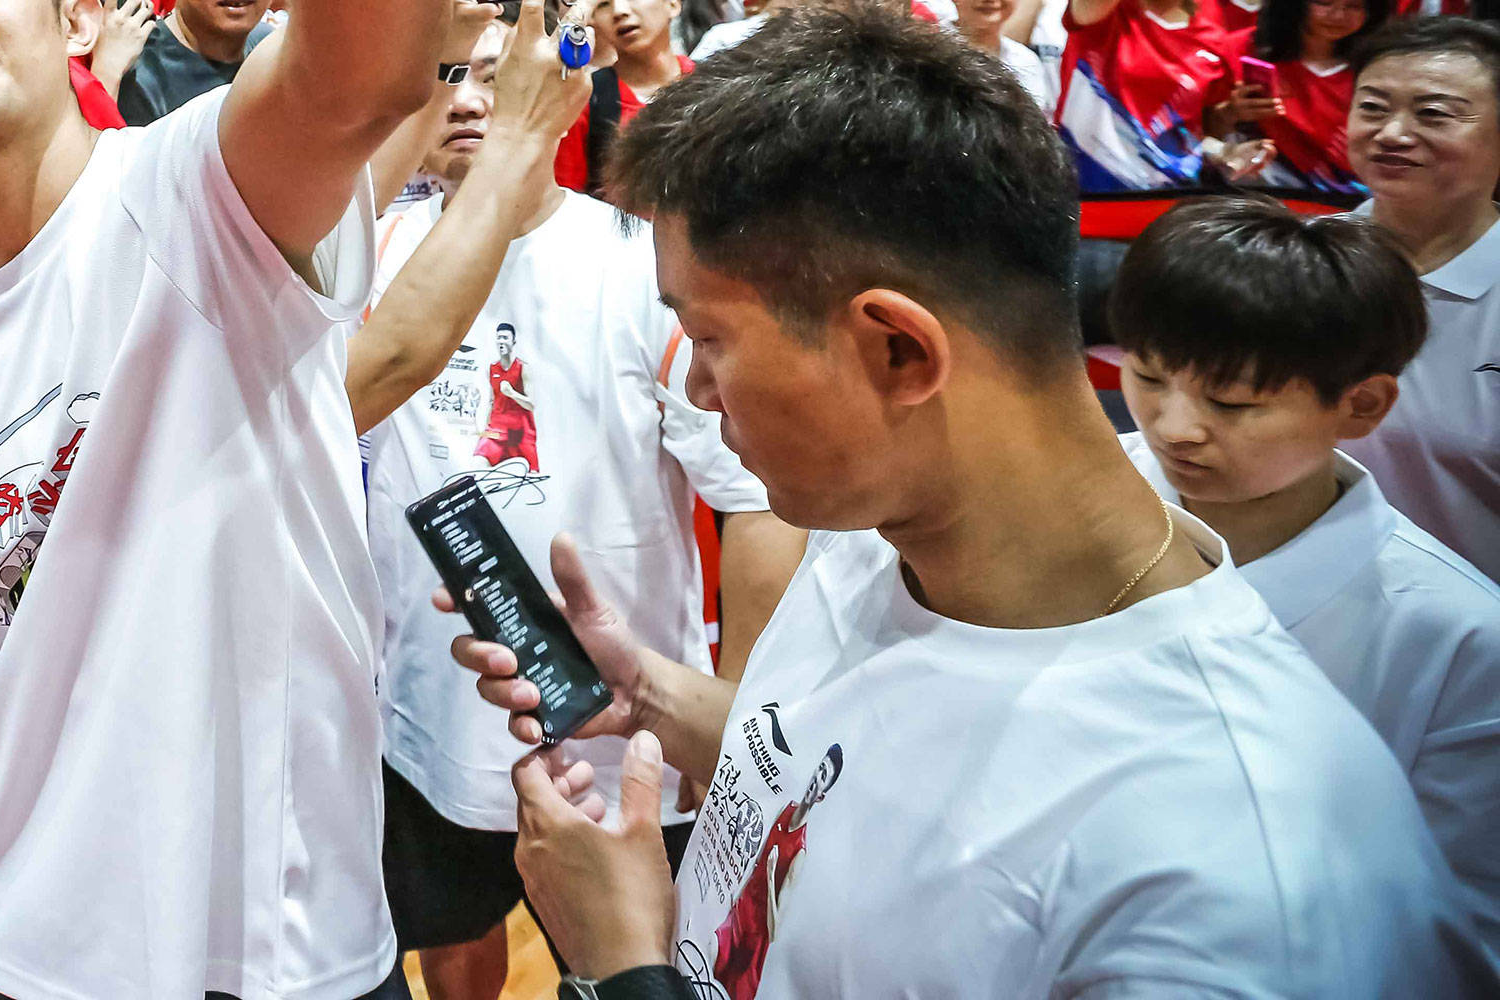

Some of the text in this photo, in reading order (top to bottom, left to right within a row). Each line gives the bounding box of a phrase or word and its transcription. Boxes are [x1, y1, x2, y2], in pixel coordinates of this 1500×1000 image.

[743, 721, 783, 796] IS POSSIBLE
[750, 717, 780, 777] ANYTHING
[711, 864, 726, 905] TOKYO
[720, 833, 743, 885] LONDON
